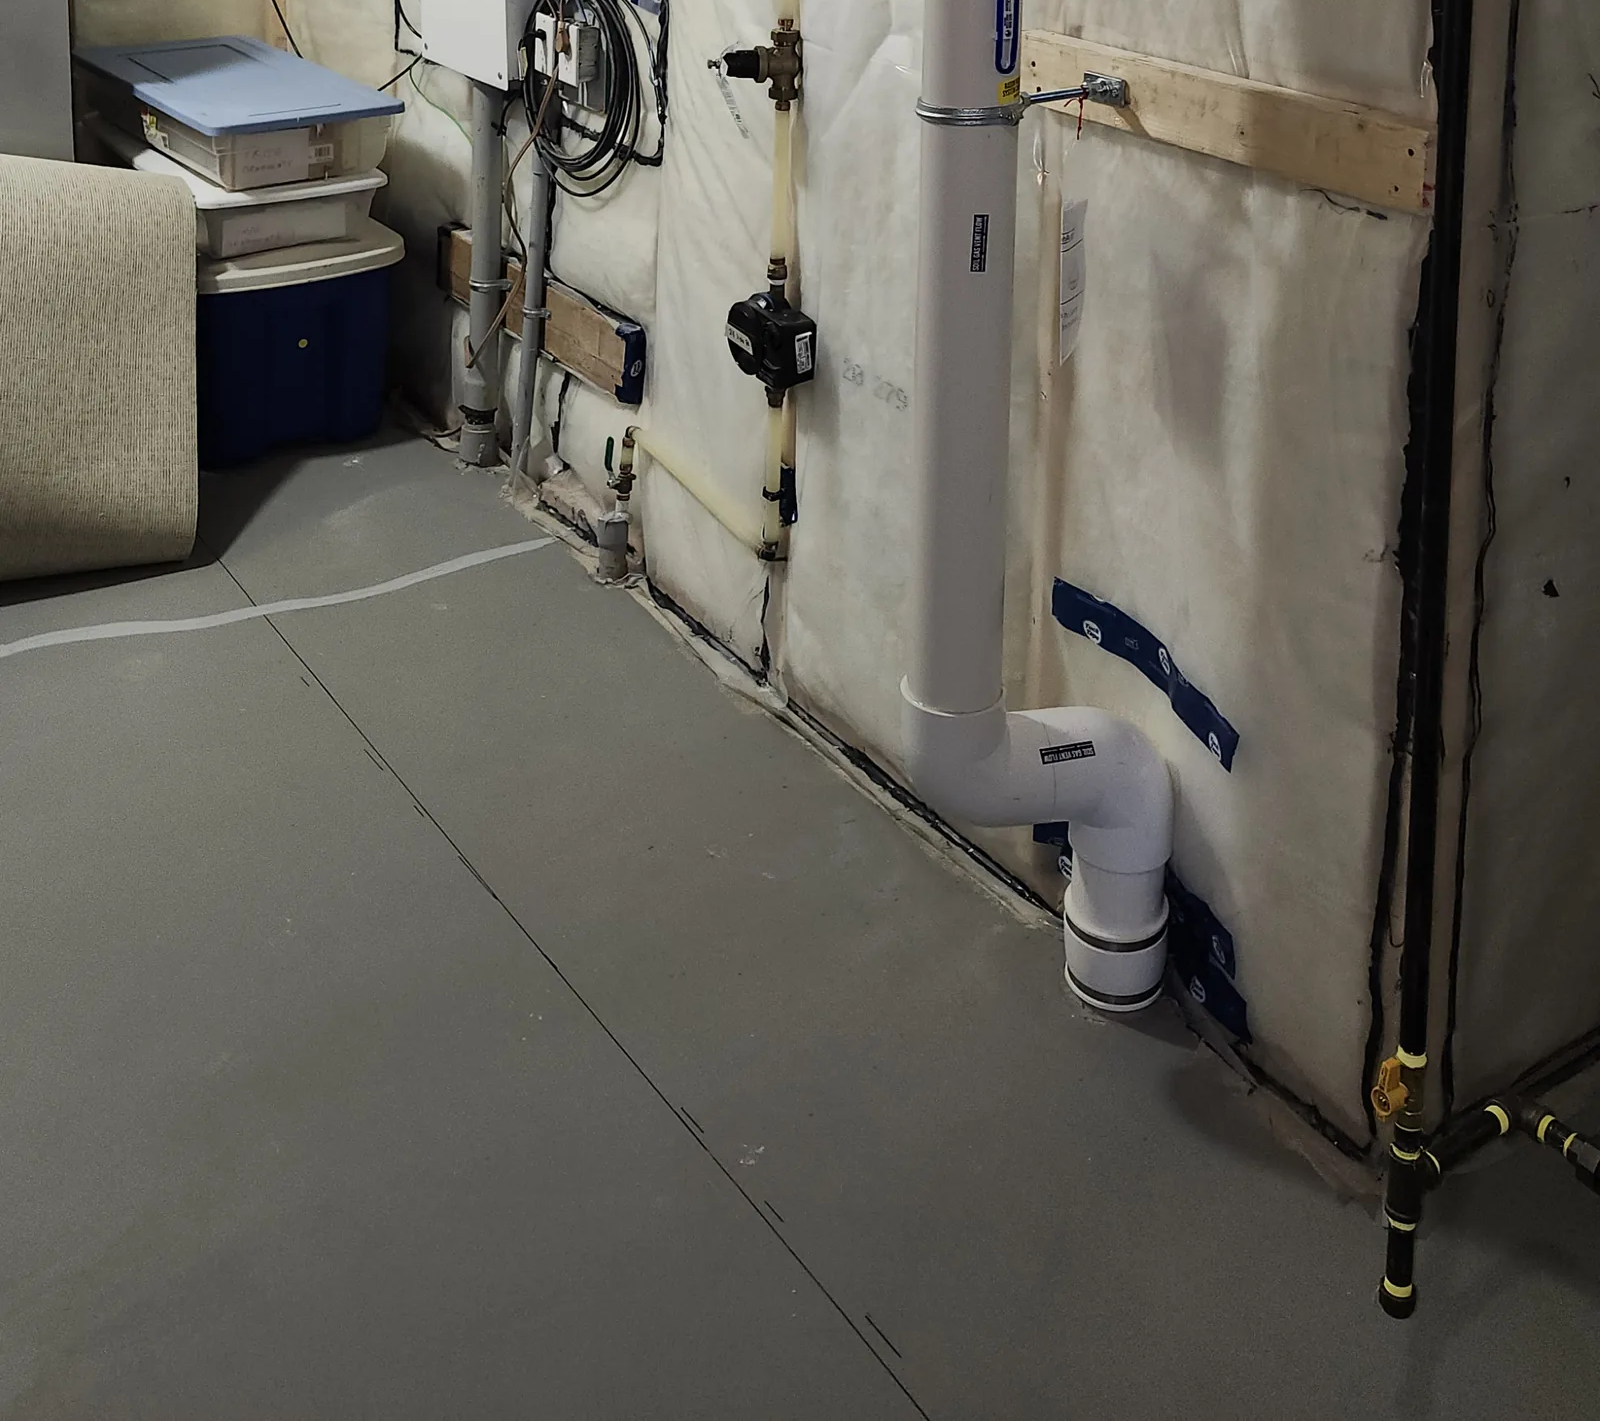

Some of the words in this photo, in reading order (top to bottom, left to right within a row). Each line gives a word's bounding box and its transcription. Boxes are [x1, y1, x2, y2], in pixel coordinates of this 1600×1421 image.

[975, 216, 984, 232] FLOW
[974, 232, 982, 247] VENT
[973, 247, 981, 259] GAS
[972, 259, 980, 271] SOIL
[1043, 753, 1059, 763] FLOW
[1059, 751, 1072, 760] VENT
[1071, 749, 1082, 758] GAS
